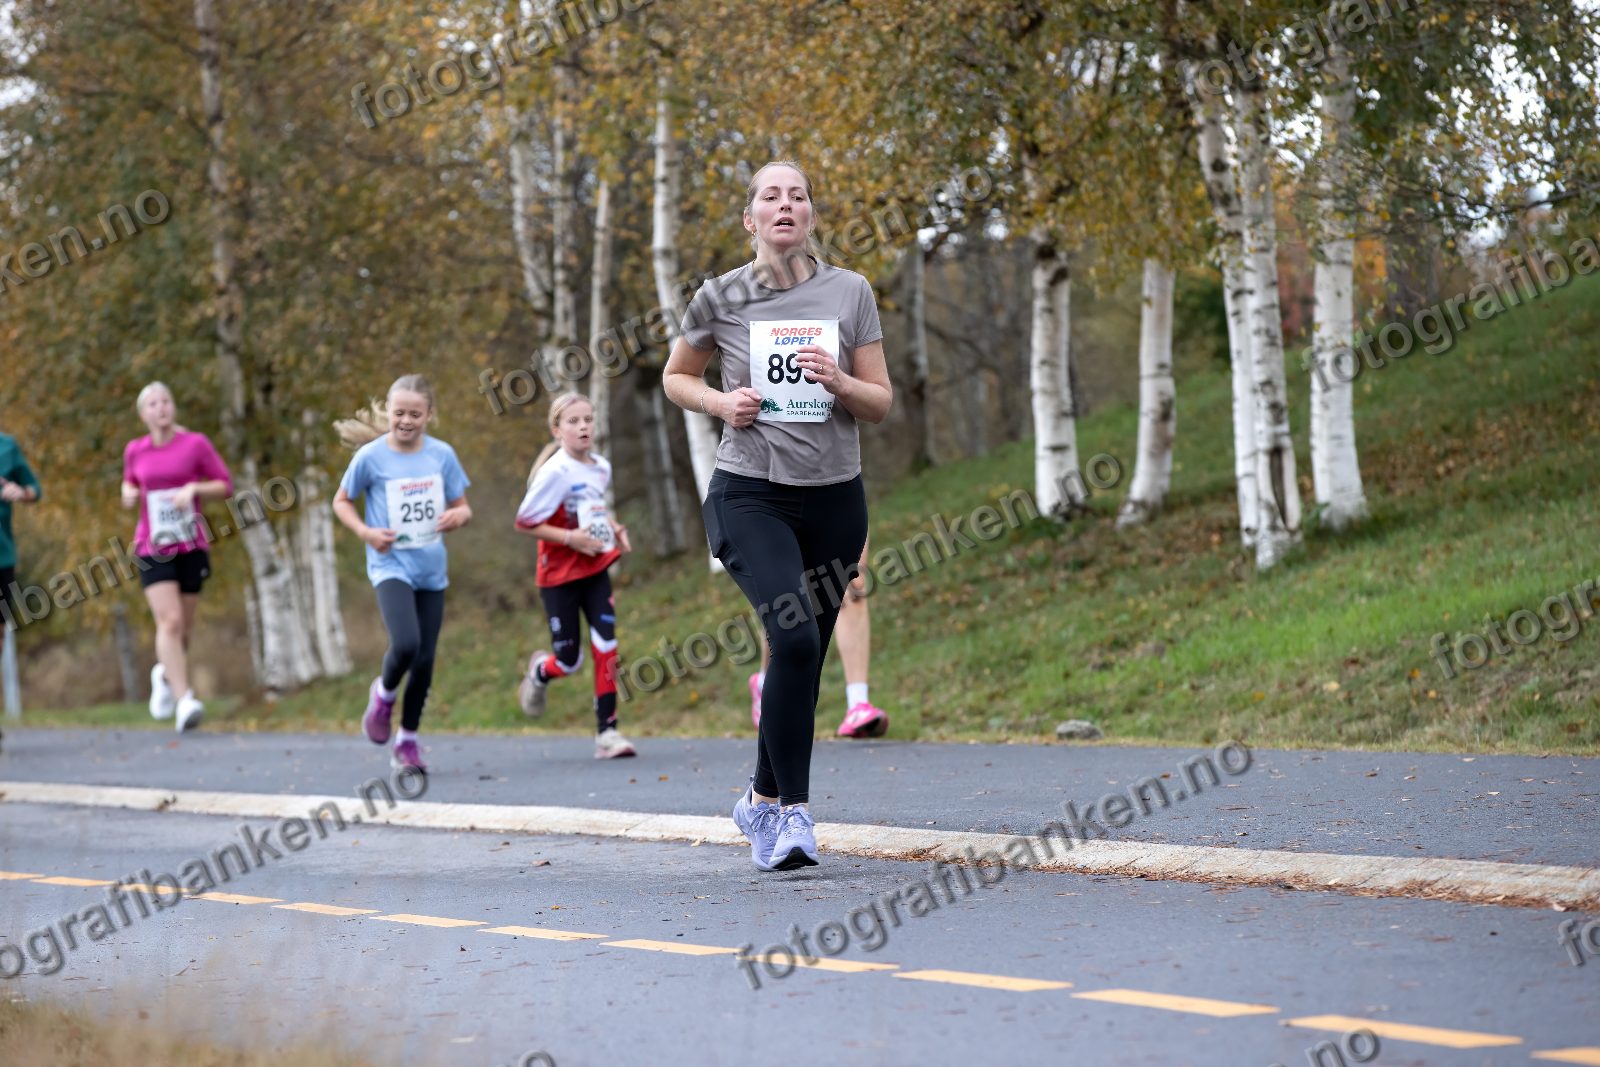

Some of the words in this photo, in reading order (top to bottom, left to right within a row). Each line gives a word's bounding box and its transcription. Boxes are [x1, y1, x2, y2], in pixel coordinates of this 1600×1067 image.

[770, 327, 823, 337] NORGES
[774, 336, 814, 345] LØPET
[767, 353, 819, 385] 89
[786, 398, 833, 412] Aurskog
[400, 499, 436, 524] 256
